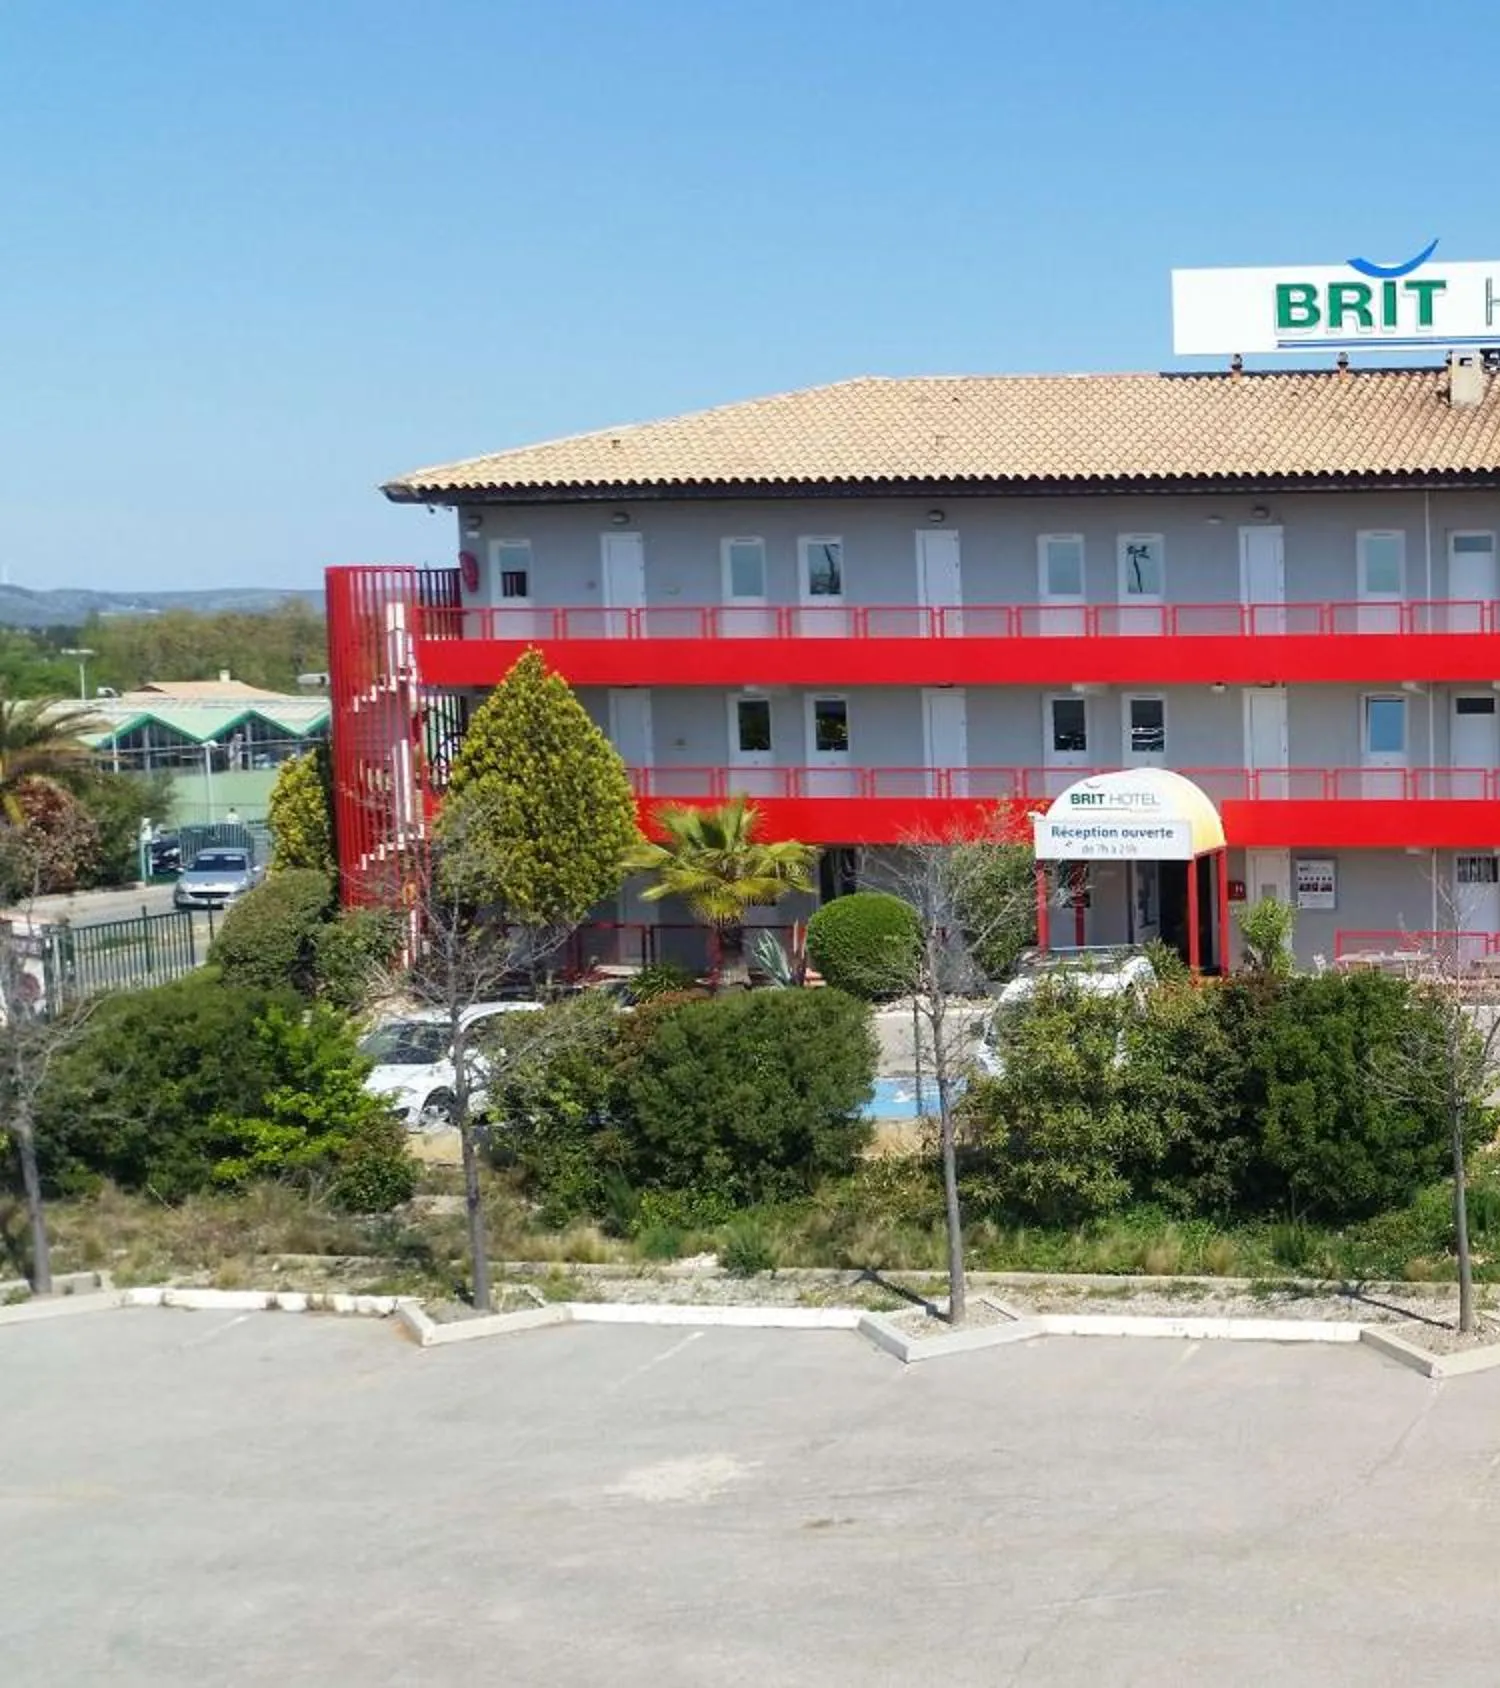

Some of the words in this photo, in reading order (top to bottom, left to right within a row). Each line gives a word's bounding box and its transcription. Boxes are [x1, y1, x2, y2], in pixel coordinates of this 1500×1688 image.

[1275, 279, 1447, 333] BRIT
[1070, 793, 1105, 805] BRIT
[1109, 793, 1161, 806] HOTEL
[1051, 825, 1118, 840] Réception
[1121, 827, 1174, 838] ouverte
